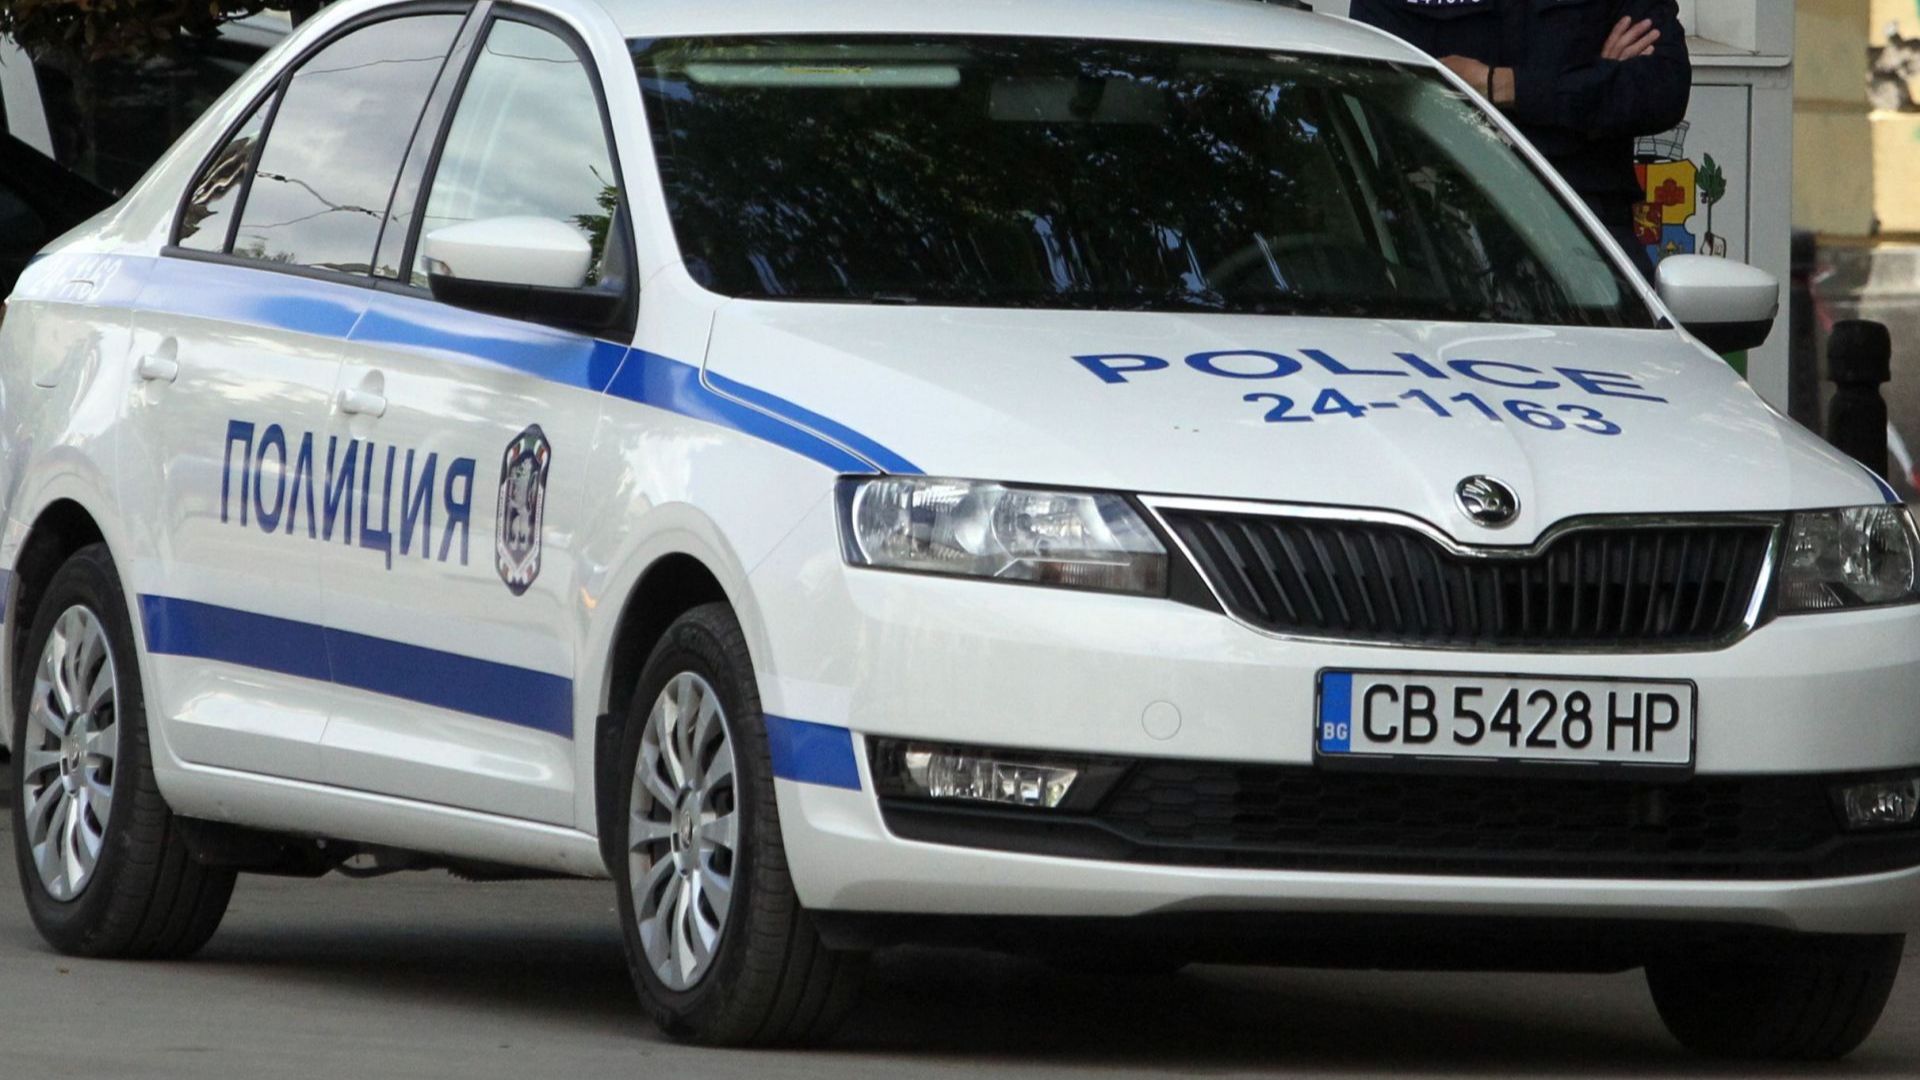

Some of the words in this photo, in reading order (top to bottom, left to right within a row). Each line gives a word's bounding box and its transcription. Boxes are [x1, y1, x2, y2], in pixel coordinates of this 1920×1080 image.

[1071, 349, 1669, 404] POLICE
[1242, 387, 1622, 436] 24-1163
[220, 419, 476, 571] ПОЛИЦИЯ
[1323, 722, 1348, 740] BG
[1452, 686, 1593, 749] 5428
